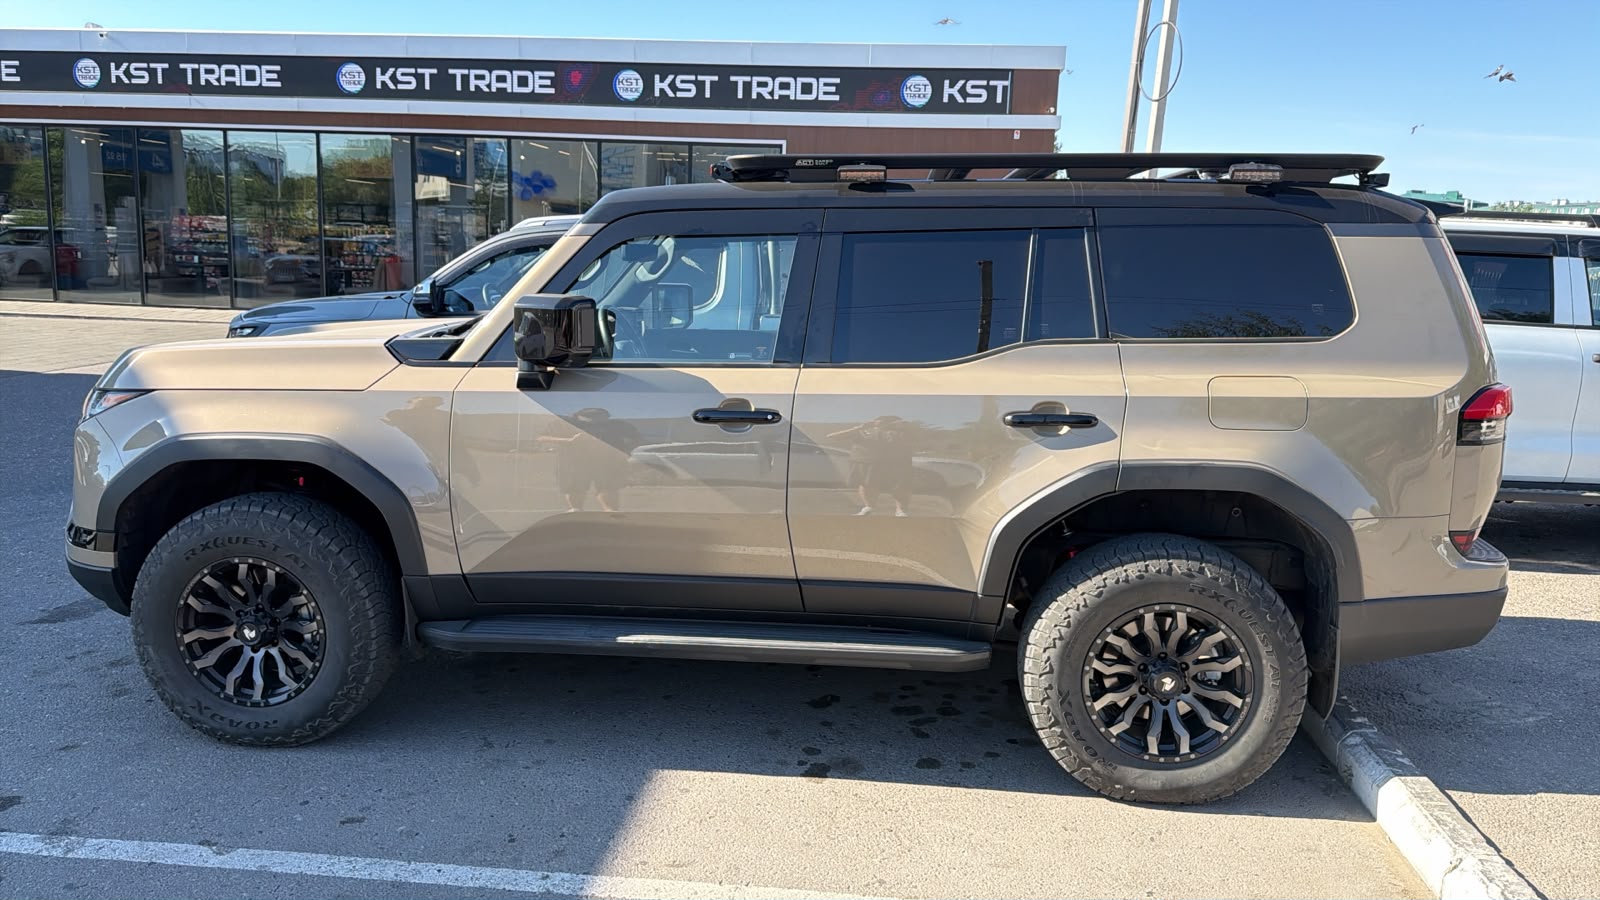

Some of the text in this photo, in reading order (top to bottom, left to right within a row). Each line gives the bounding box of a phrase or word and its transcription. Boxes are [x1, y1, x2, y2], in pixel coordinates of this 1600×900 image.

[77, 66, 97, 74] KST
[110, 62, 282, 88] KST TRADE
[340, 71, 363, 80] KST
[375, 67, 556, 94] KST TRADE
[617, 78, 640, 87] KST
[654, 74, 841, 102] KST TRADE
[905, 83, 930, 92] KST
[942, 79, 1009, 104] KST
[190, 698, 279, 730] ROADX
